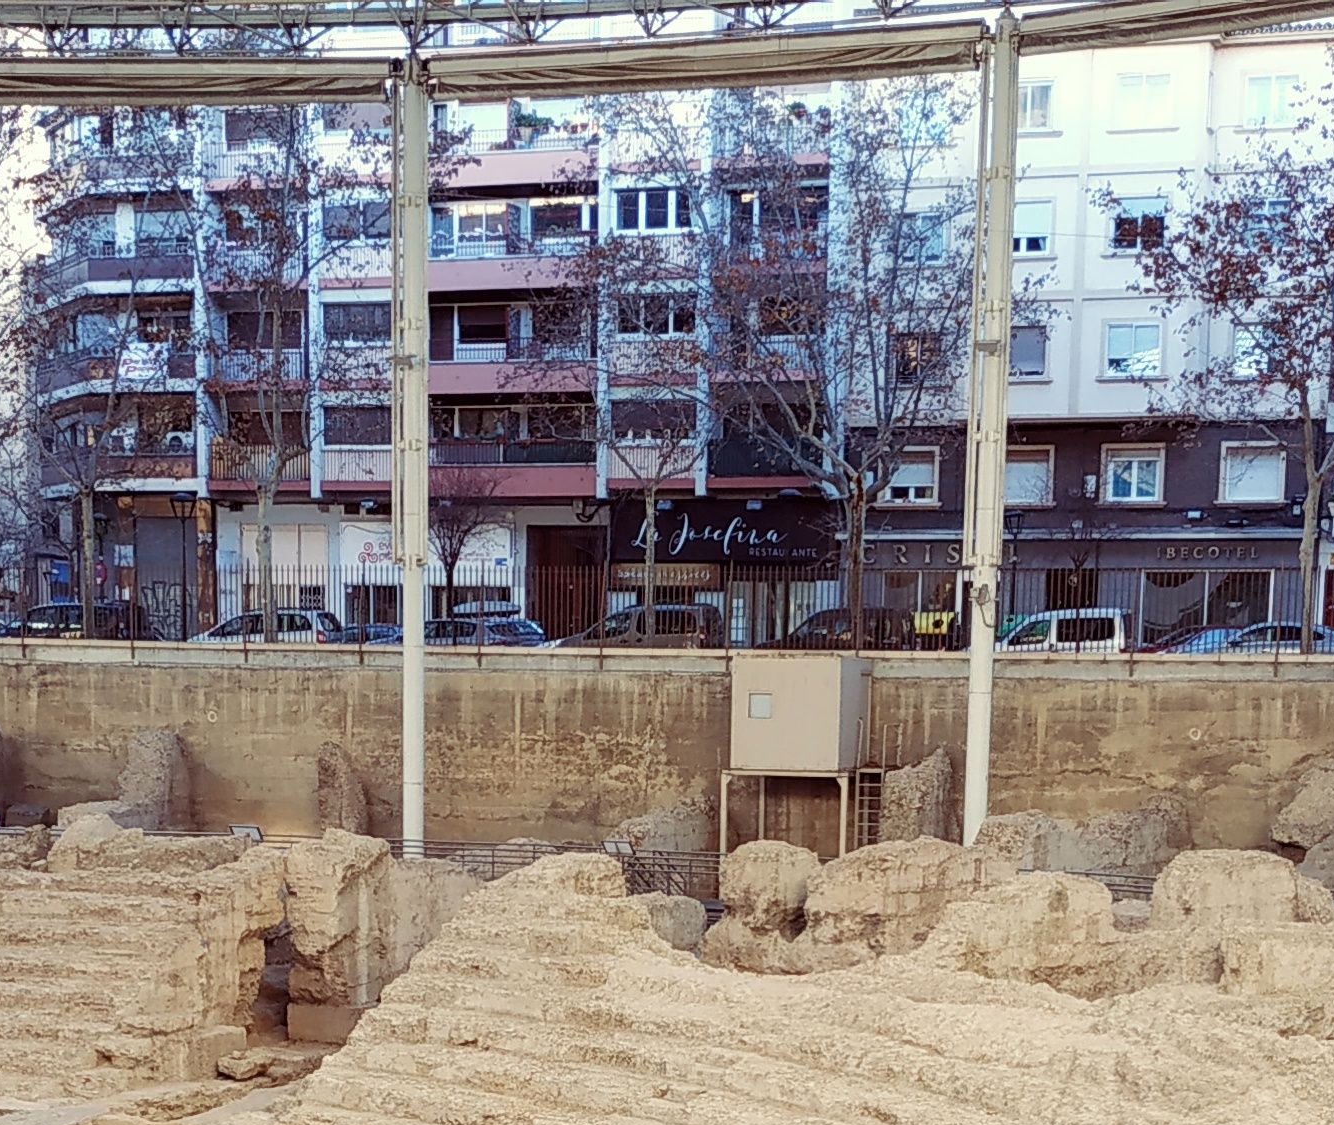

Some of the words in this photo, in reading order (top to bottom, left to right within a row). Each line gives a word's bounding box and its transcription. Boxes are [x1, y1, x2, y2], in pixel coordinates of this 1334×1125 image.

[669, 513, 788, 555] Josefina
[748, 547, 817, 558] RESTAUANTE
[862, 544, 1021, 563] CRISL
[1156, 546, 1259, 559] IBECOTEL
